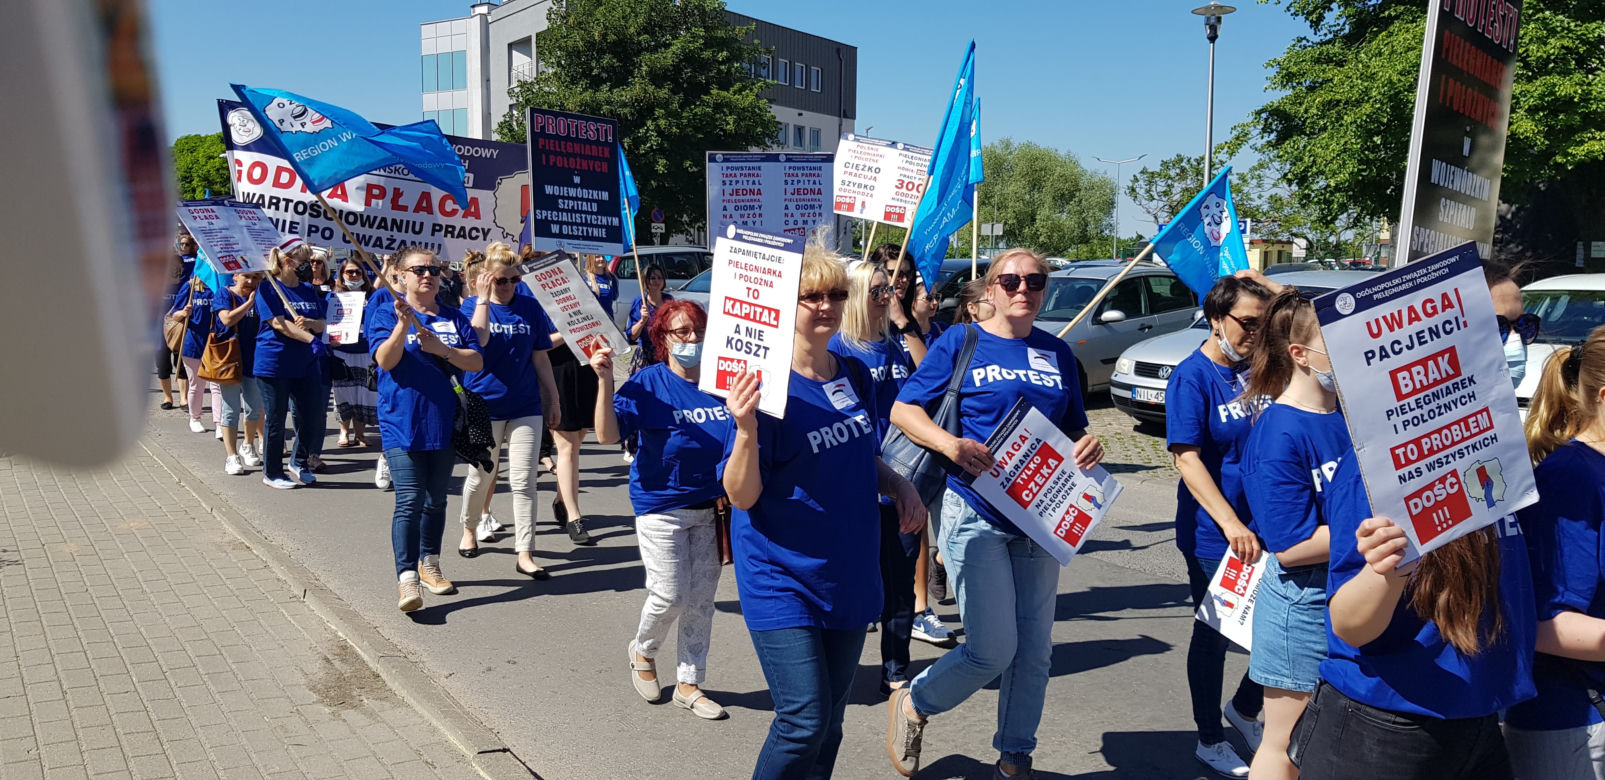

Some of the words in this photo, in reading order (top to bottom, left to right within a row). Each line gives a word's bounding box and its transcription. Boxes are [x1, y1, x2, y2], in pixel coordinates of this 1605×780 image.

[533, 113, 614, 143] PROTEST!
[292, 137, 339, 163] REGION
[538, 138, 611, 158] PIELĘGNIAREK
[1463, 135, 1471, 157] W
[541, 154, 546, 166] I
[549, 154, 609, 173] POŁOŻNYCH
[843, 161, 882, 174] CIĘŻKO
[544, 184, 609, 201] WOJEWÓDZKIM
[573, 175, 581, 184] W
[728, 188, 763, 197] JEDNA
[790, 187, 823, 196] JEDNA
[840, 179, 876, 191] SZYBKO
[1430, 158, 1491, 201] WOJEWÓDZKIM
[241, 191, 425, 236] WARTOŚCIOWANIU
[363, 182, 482, 221] PŁACA
[558, 199, 598, 213] SZPITALU
[733, 204, 763, 212] OIOM-Y
[1438, 197, 1476, 230] SZPITALU
[535, 209, 620, 227] SPECJALISTYCZNYM
[550, 223, 561, 234] W
[562, 224, 607, 238] OLSZTYNIE
[306, 223, 335, 241] PO
[1176, 222, 1206, 256] REGION
[729, 246, 785, 264] ZAPAMIĘTAJCIE:
[534, 266, 565, 283] GODNA
[728, 259, 783, 278] PIELĘGNIARKA
[738, 273, 774, 289] POŁOŻNA
[1355, 277, 1402, 299] OGÓLNOPOLSKI
[1401, 268, 1428, 282] ZWIĄZEK
[1427, 254, 1460, 273] ZAWODOWY
[746, 286, 760, 300] TO
[724, 298, 778, 326] KAPITAŁ
[489, 323, 532, 335] ROTEST
[734, 323, 741, 335] A
[745, 326, 765, 342] NIE
[725, 335, 770, 360] KOSZT
[972, 364, 1063, 391] PROTEST
[1396, 352, 1455, 395] BRAK
[1135, 387, 1151, 401] NIL
[1153, 390, 1166, 402] 45
[1385, 374, 1477, 421] PIELĘGNIAREK
[1393, 423, 1399, 435] I
[1402, 390, 1477, 432] POŁOŻNYCH
[806, 412, 874, 454] PROTE
[1395, 443, 1418, 465] TO
[1421, 411, 1491, 455] PROBLEM
[988, 427, 1033, 479] UWAGA!
[1000, 436, 1043, 490] ZAGRANICA
[1398, 466, 1423, 485] NAS
[1424, 433, 1499, 474] WSZYSTKICH
[1015, 455, 1042, 486] TYLKO
[1021, 458, 1060, 502] CZEKA
[1035, 495, 1045, 510] NA
[1043, 468, 1068, 499] POLSKIE
[1038, 471, 1076, 518] PIELĘGNIARKI
[1052, 480, 1078, 513] POŁOŻNE
[1408, 474, 1460, 516] DOŚĆ
[1056, 505, 1079, 538] DOŚĆ
[1072, 522, 1086, 537] !!!
[1432, 506, 1453, 532] !!!
